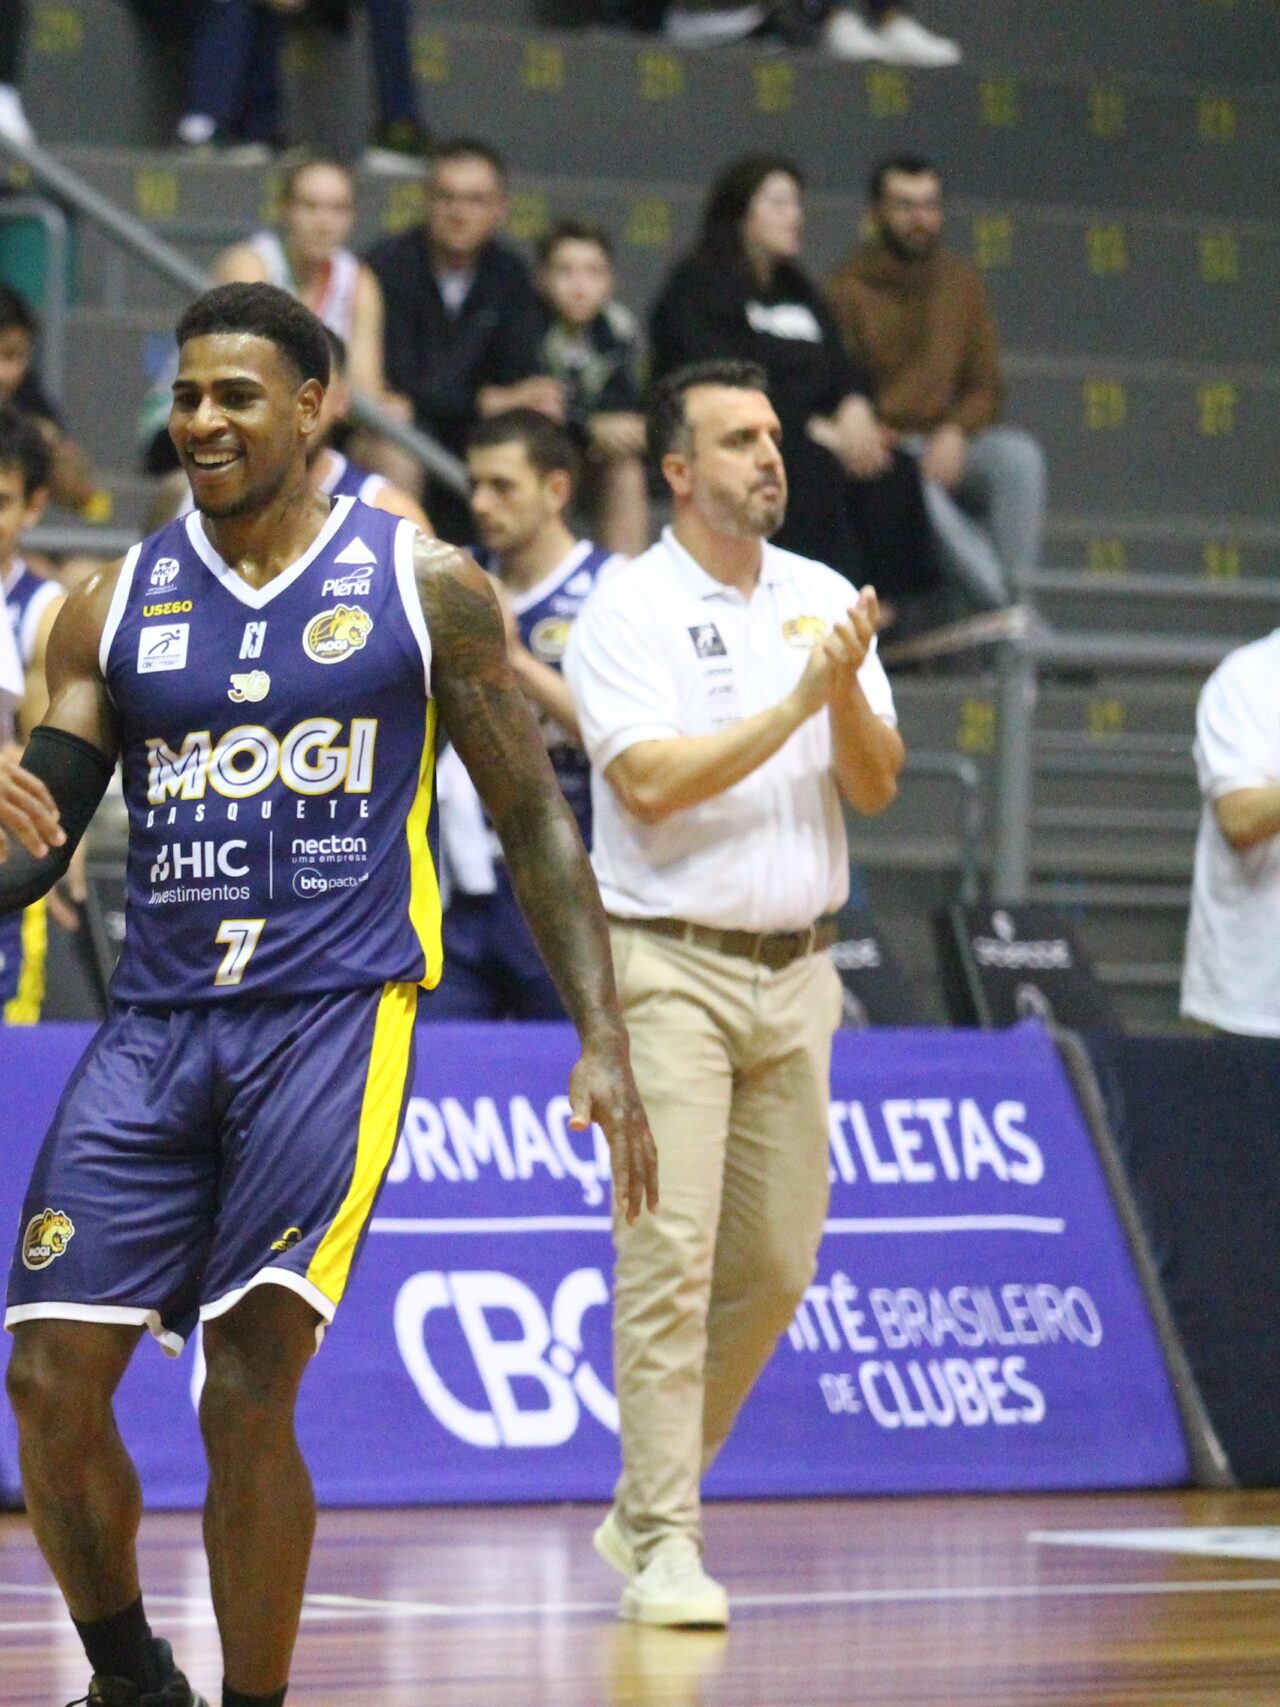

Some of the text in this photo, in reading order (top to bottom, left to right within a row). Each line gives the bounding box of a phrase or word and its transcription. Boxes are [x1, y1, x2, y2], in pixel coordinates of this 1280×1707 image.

[321, 578, 371, 597] Plena
[145, 718, 378, 805] MOGI
[146, 799, 369, 829] BASQUETE
[172, 839, 251, 880] HIC
[291, 834, 367, 854] necton
[318, 854, 368, 863] empresa
[148, 883, 251, 904] Investimentos
[214, 918, 267, 986] 7
[387, 1094, 612, 1206] RMAÇ
[828, 1097, 1045, 1184] TLETAS
[869, 1283, 1103, 1348] BRASILEIRO
[818, 1355, 1047, 1429] DE CLUBES
